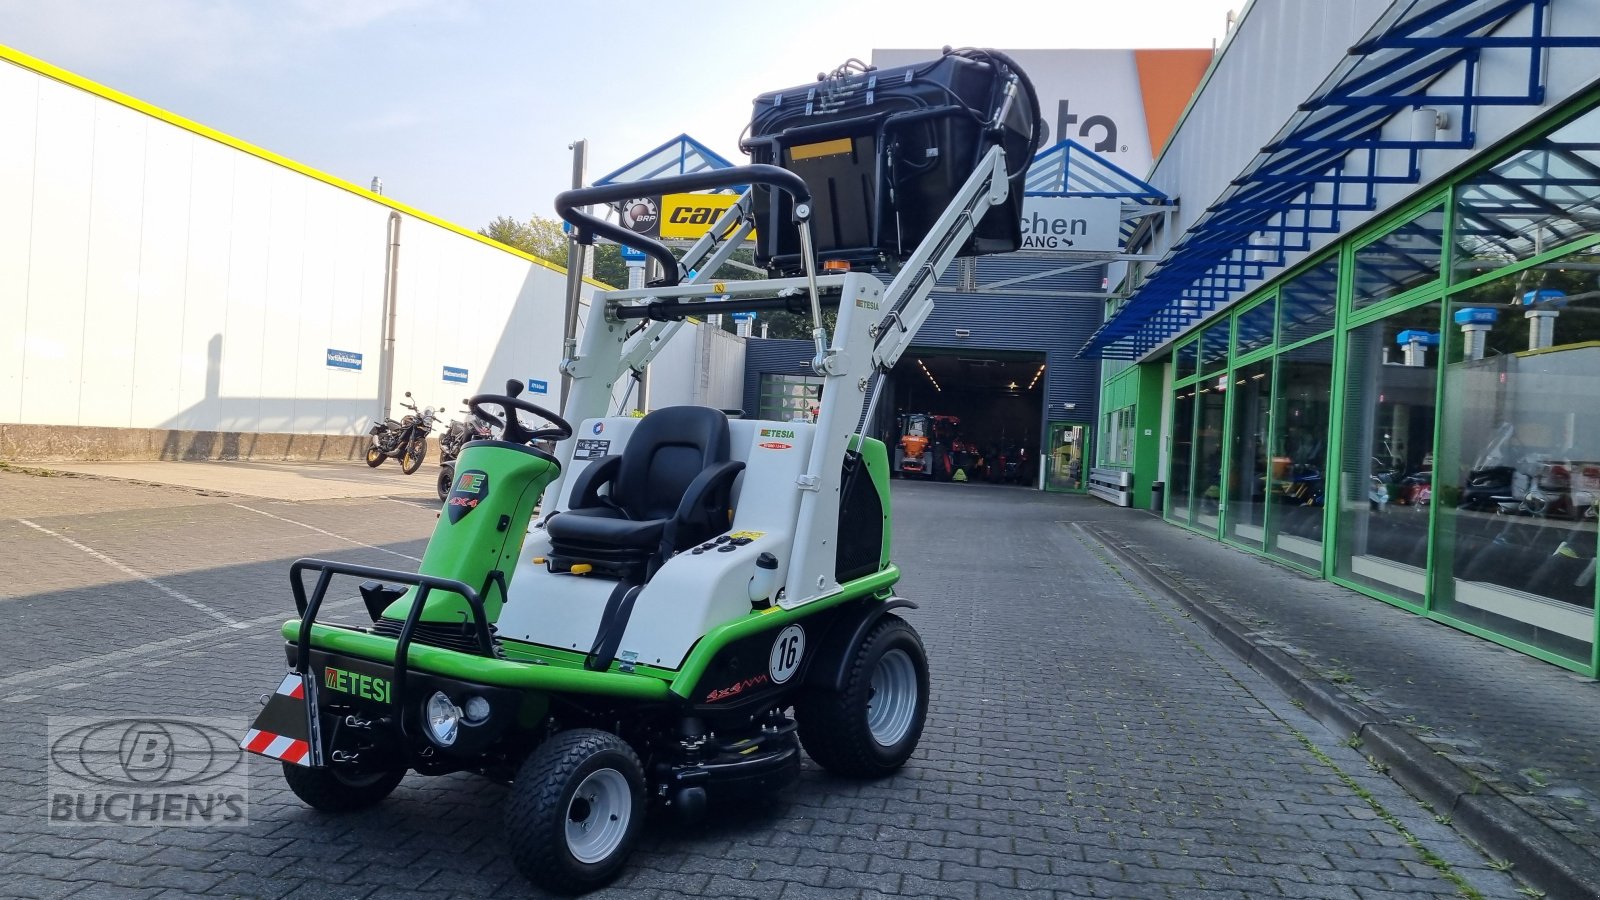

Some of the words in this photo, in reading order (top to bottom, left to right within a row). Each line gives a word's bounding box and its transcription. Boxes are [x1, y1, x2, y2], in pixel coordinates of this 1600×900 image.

[1039, 99, 1118, 153] ta
[760, 429, 795, 439] ETESIA
[778, 635, 799, 672] 16
